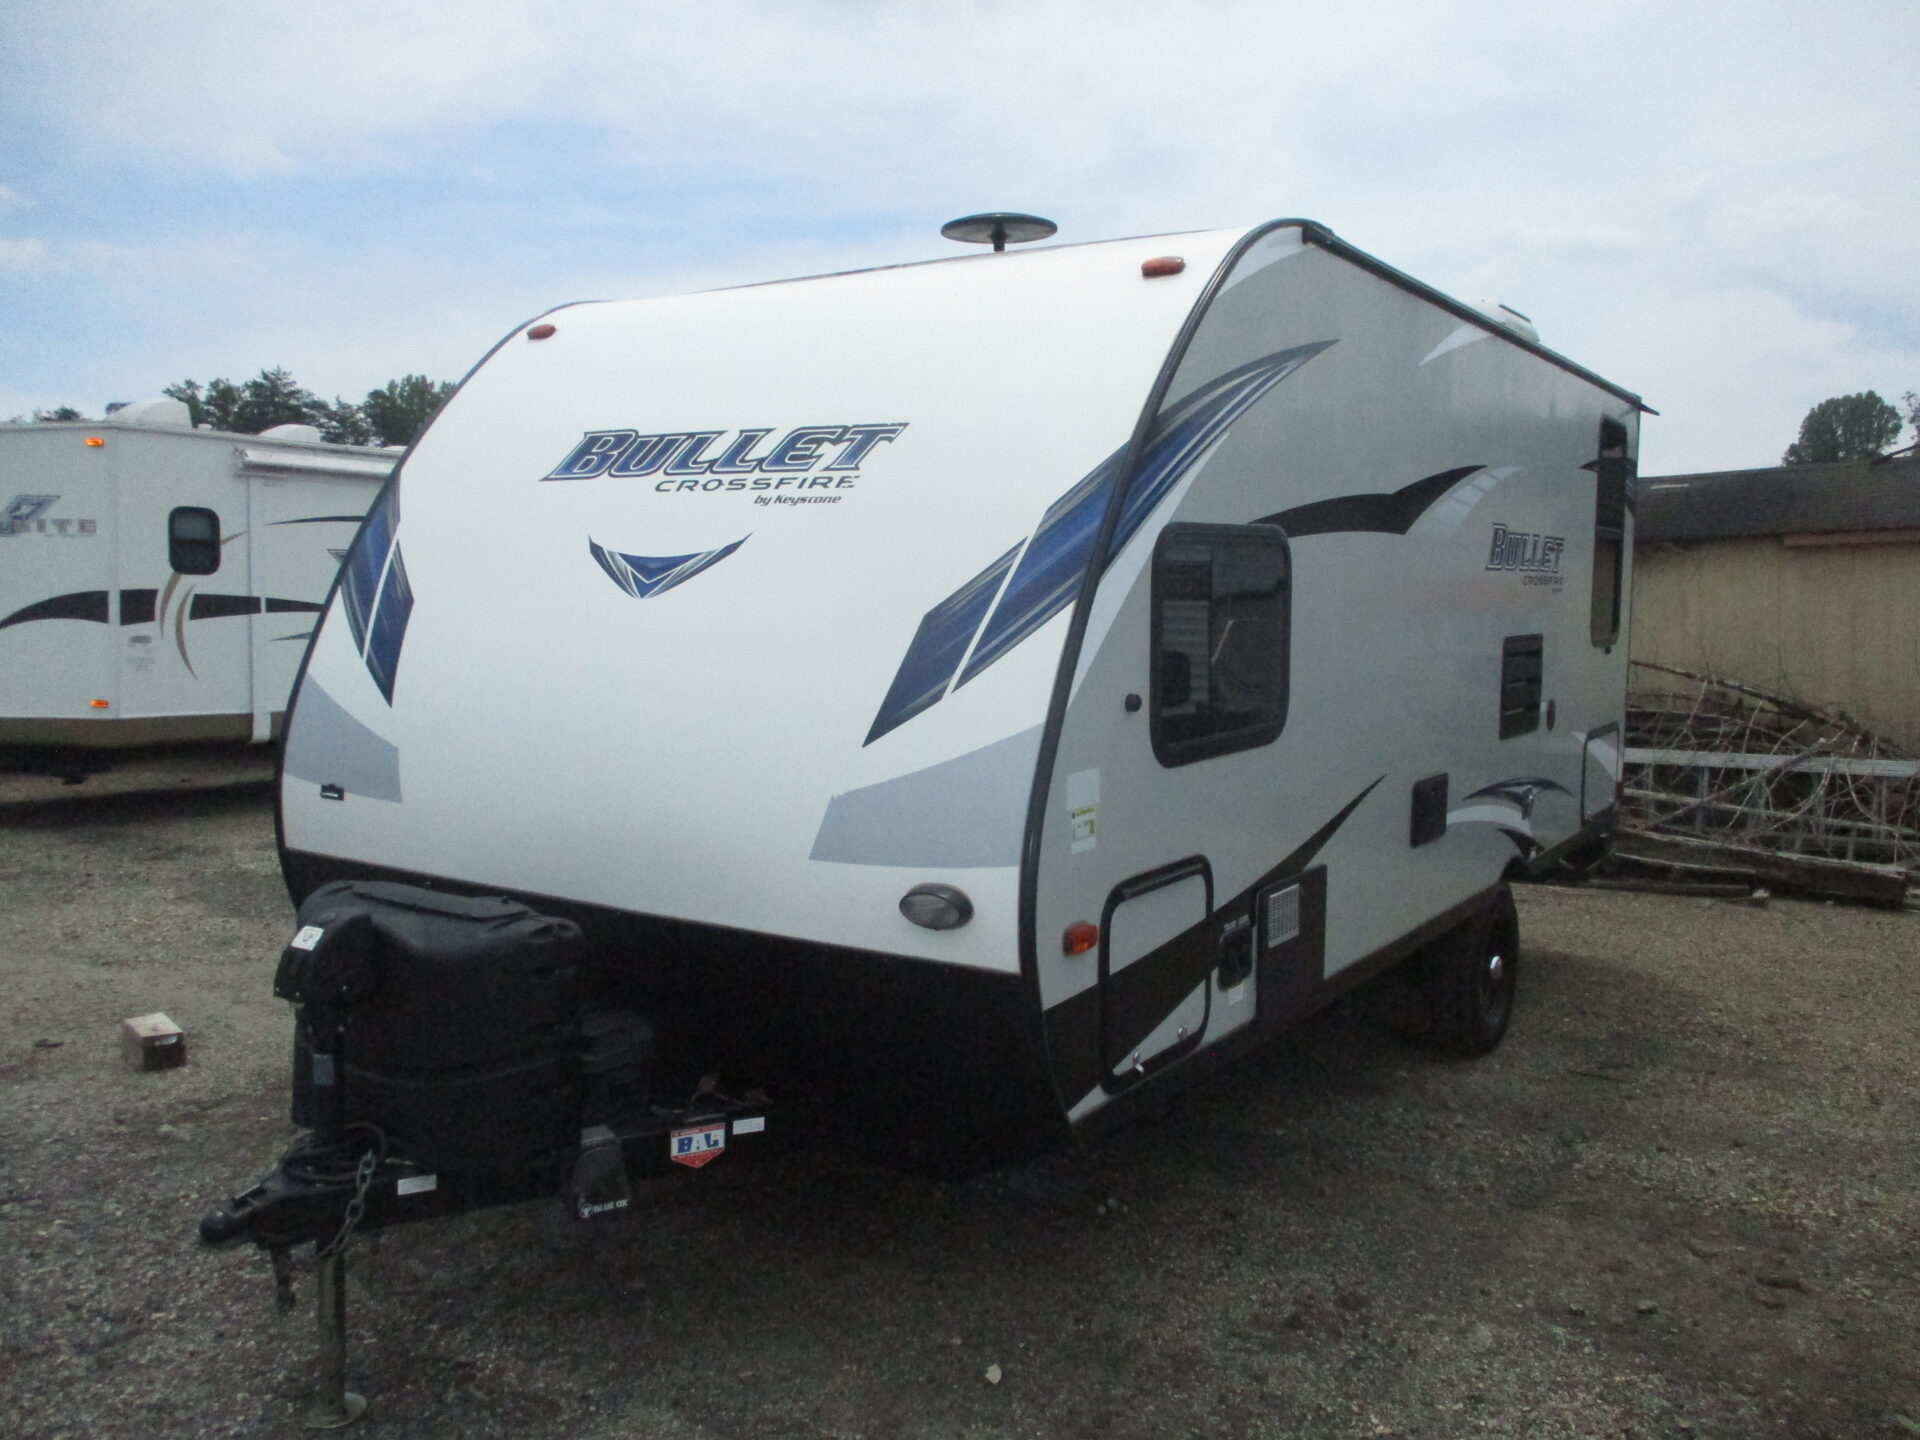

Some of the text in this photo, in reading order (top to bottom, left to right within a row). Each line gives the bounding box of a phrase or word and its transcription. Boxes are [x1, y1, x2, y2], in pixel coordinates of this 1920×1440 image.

[539, 422, 910, 481] BULLET
[654, 475, 861, 492] CROSSFIRE
[754, 494, 843, 506] by Keystone
[1485, 522, 1565, 573] BULLET
